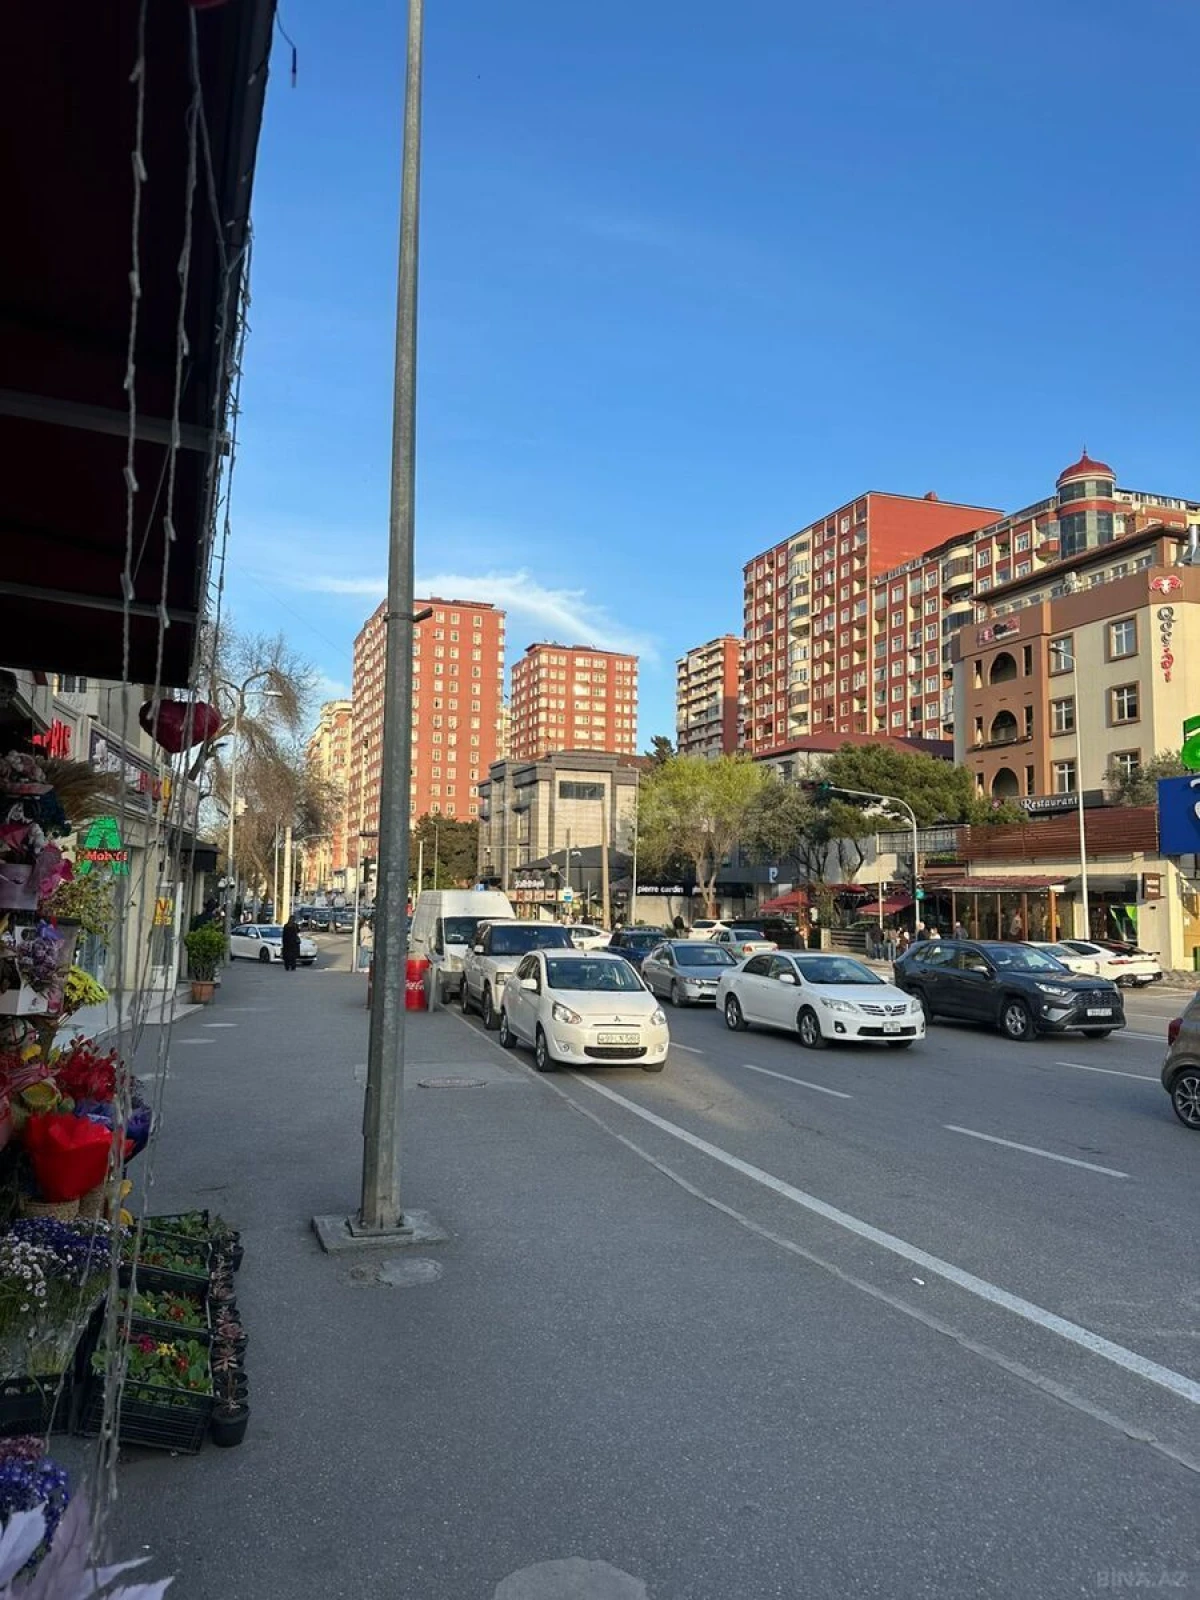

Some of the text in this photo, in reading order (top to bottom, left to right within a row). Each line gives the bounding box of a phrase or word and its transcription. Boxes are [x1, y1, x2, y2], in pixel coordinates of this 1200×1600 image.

[1020, 796, 1078, 811] Restaurant
[637, 884, 659, 893] pierre
[660, 884, 684, 893] cardin
